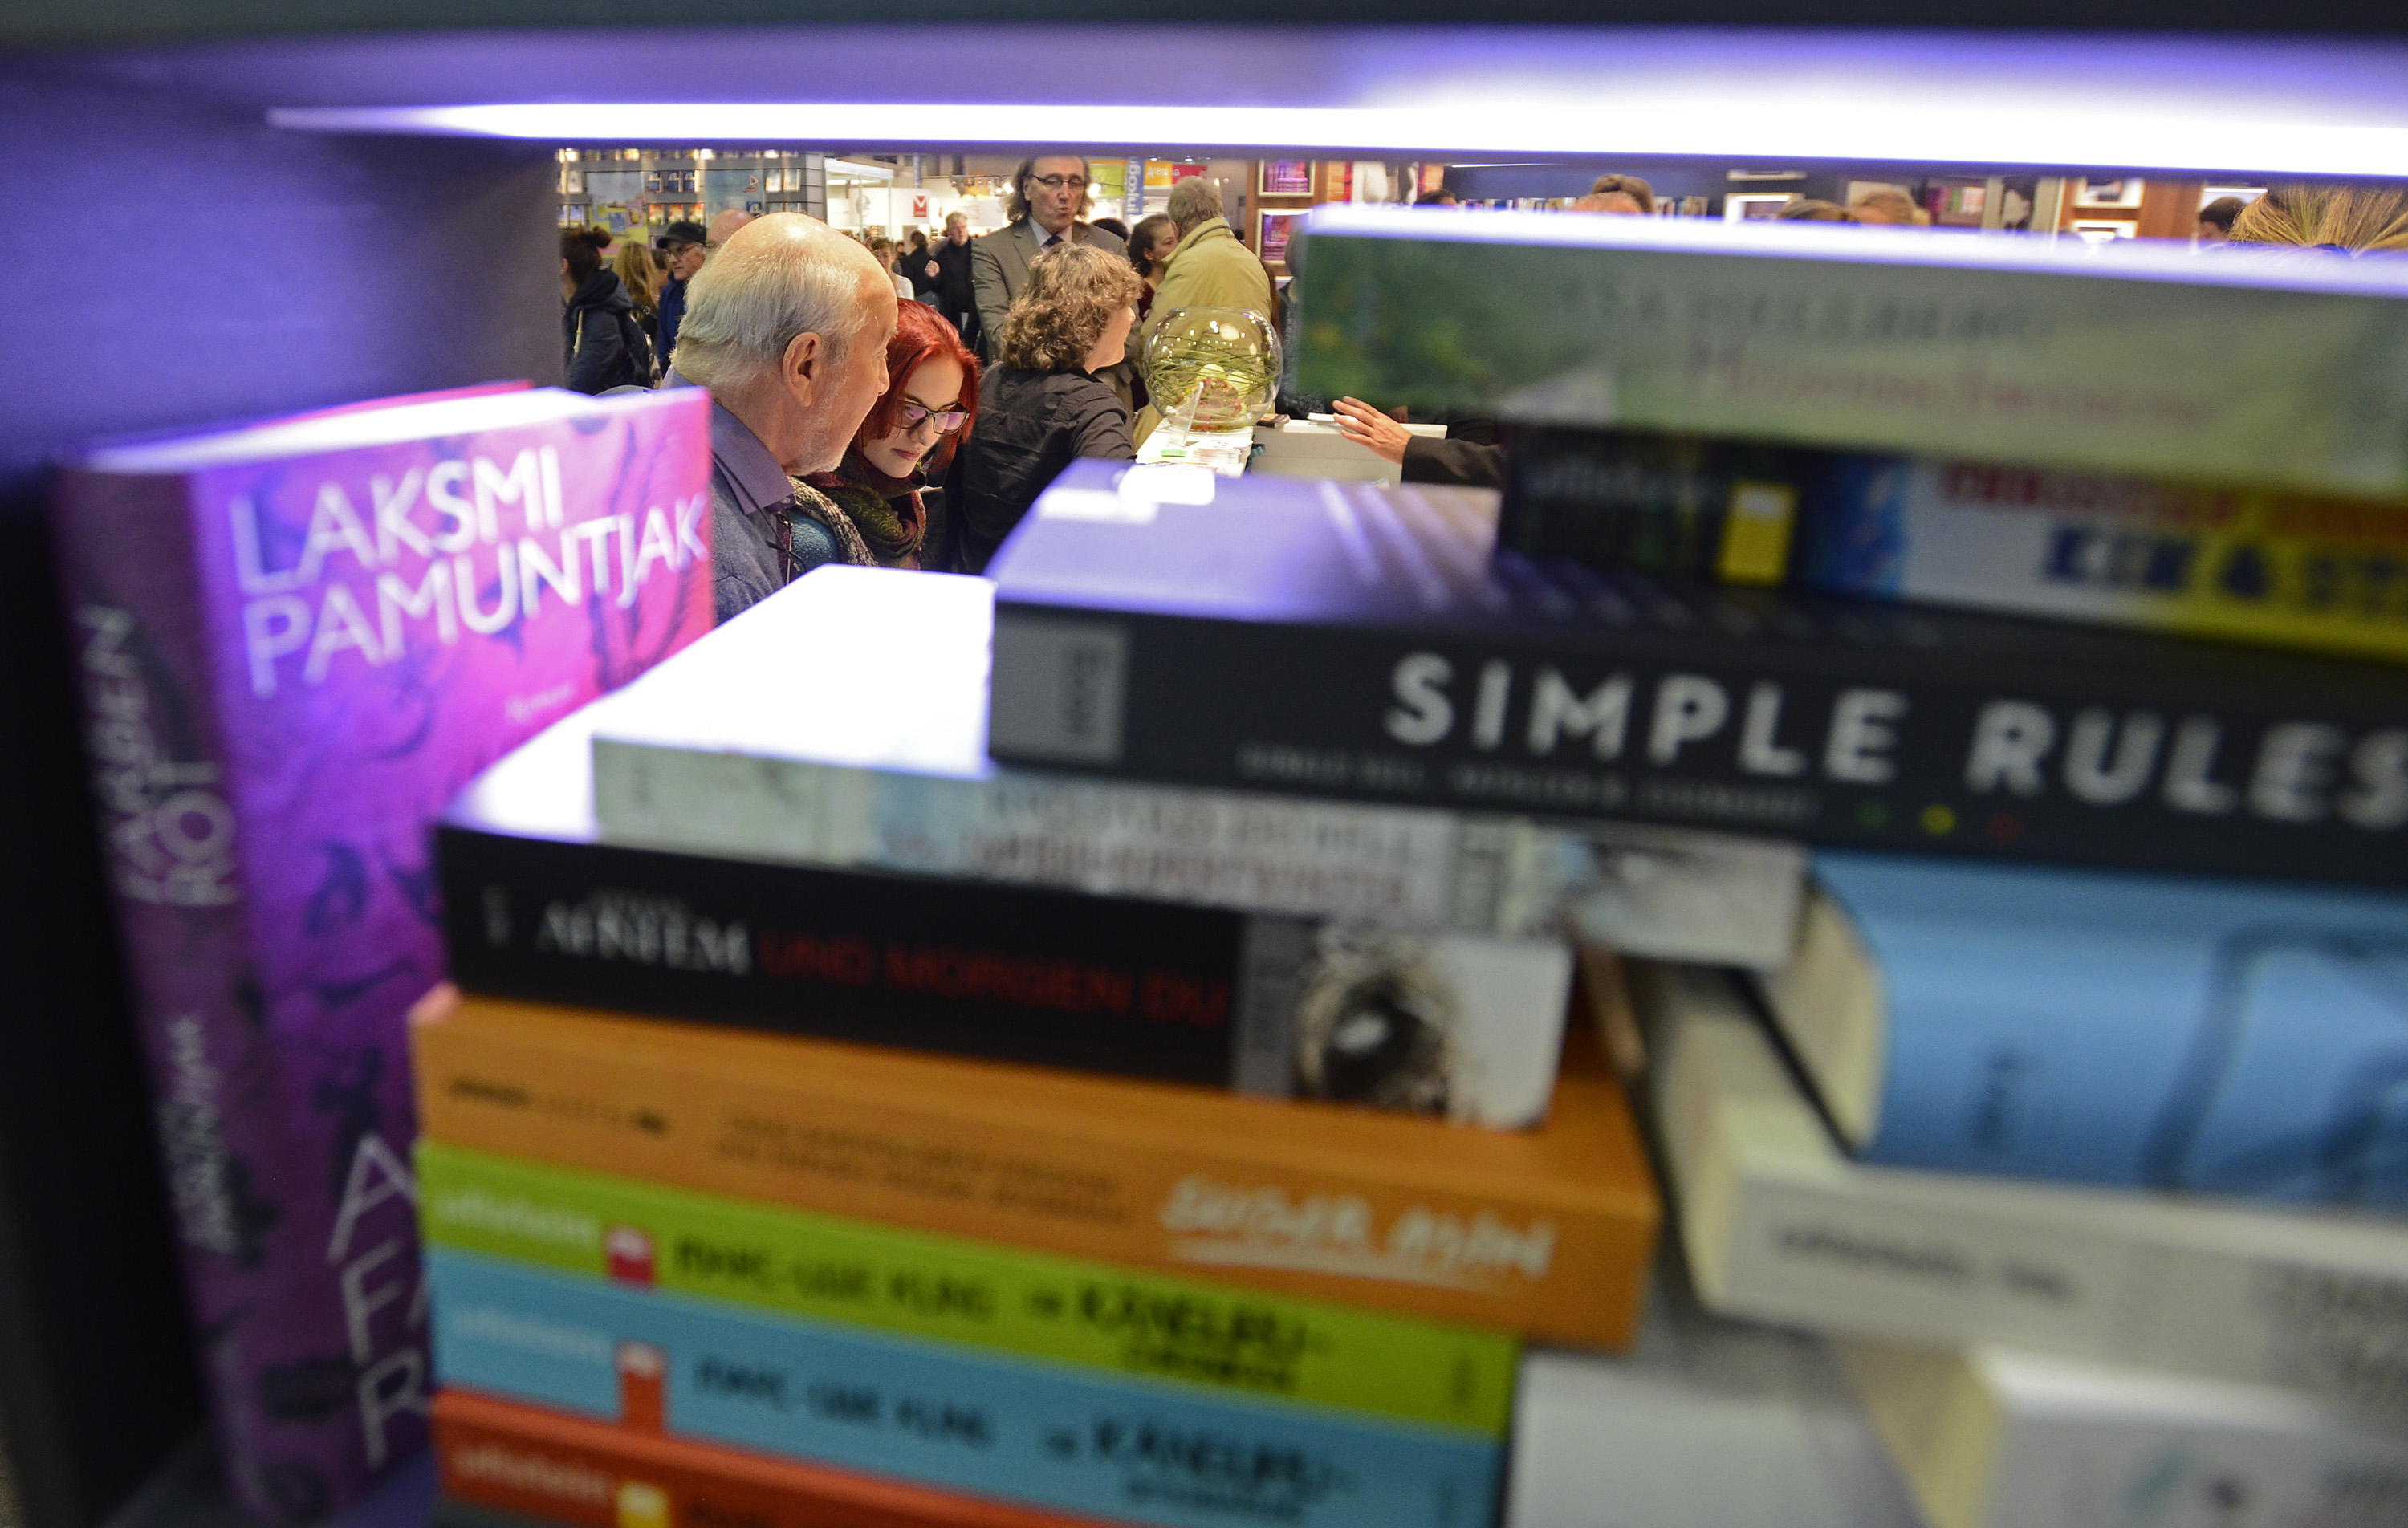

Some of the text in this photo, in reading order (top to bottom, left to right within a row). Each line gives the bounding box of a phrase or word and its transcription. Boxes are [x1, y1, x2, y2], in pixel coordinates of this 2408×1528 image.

[1146, 166, 1169, 178] Arena
[231, 443, 562, 596] LAKSMI
[242, 492, 710, 698] PAMUNTJAK
[1384, 652, 1911, 785] SIMPLE
[1964, 700, 2408, 830] RULES
